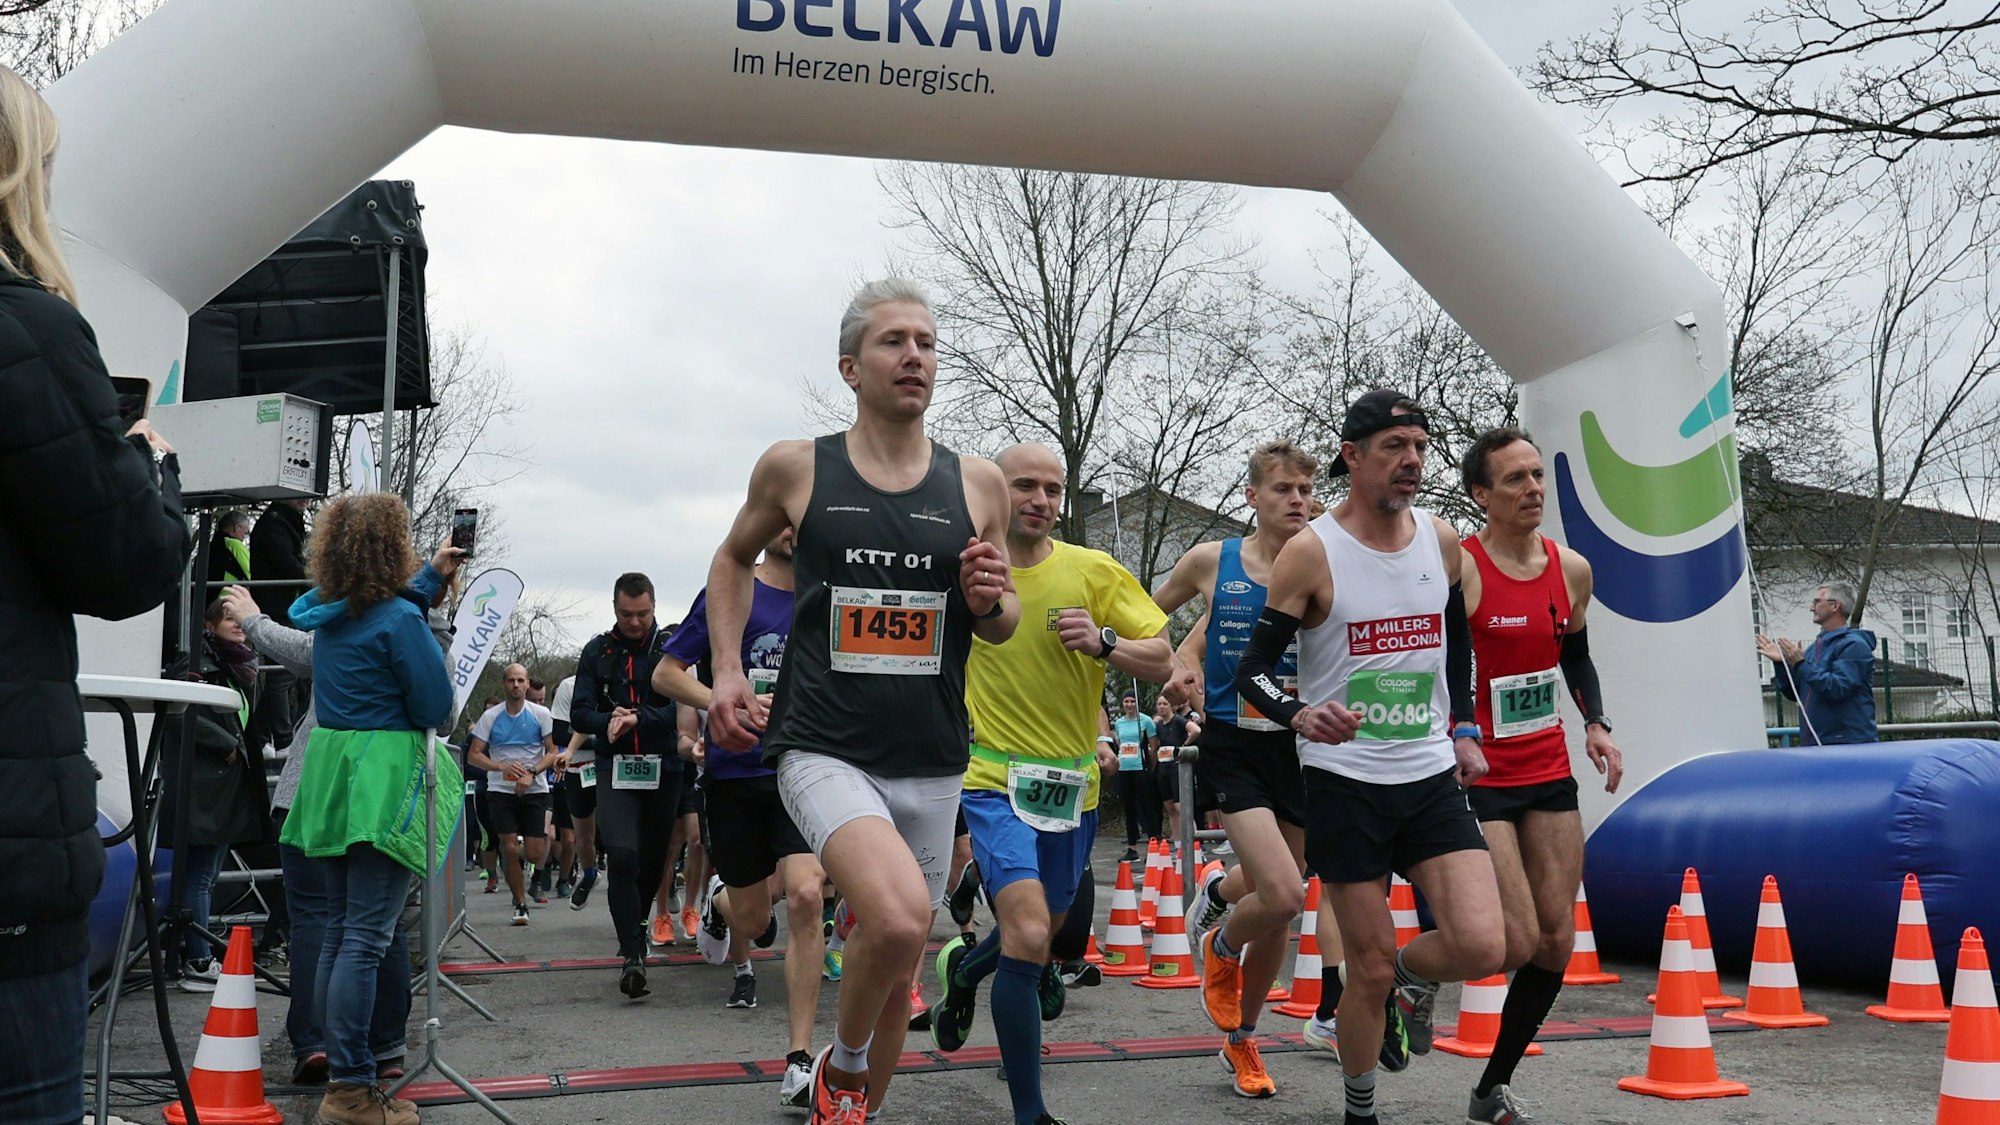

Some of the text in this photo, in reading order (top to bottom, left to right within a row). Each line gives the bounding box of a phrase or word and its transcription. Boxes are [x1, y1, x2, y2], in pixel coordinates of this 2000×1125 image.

[736, 0, 1062, 57] BELKAW
[733, 47, 995, 95] Im Herzen bergisch.
[845, 548, 932, 570] KTT 01
[837, 596, 867, 605] BELKAW
[848, 608, 928, 641] 1453
[1375, 617, 1431, 635] MILERS
[1501, 615, 1527, 624] bunert
[454, 607, 502, 687] BELKAW
[1376, 632, 1441, 650] COLONIA
[1251, 672, 1285, 701] TERREX
[1380, 678, 1418, 687] COLOGNE
[1505, 683, 1552, 712] 1214
[1350, 700, 1429, 726] 20680
[624, 762, 651, 776] 585
[1026, 780, 1069, 807] 370
